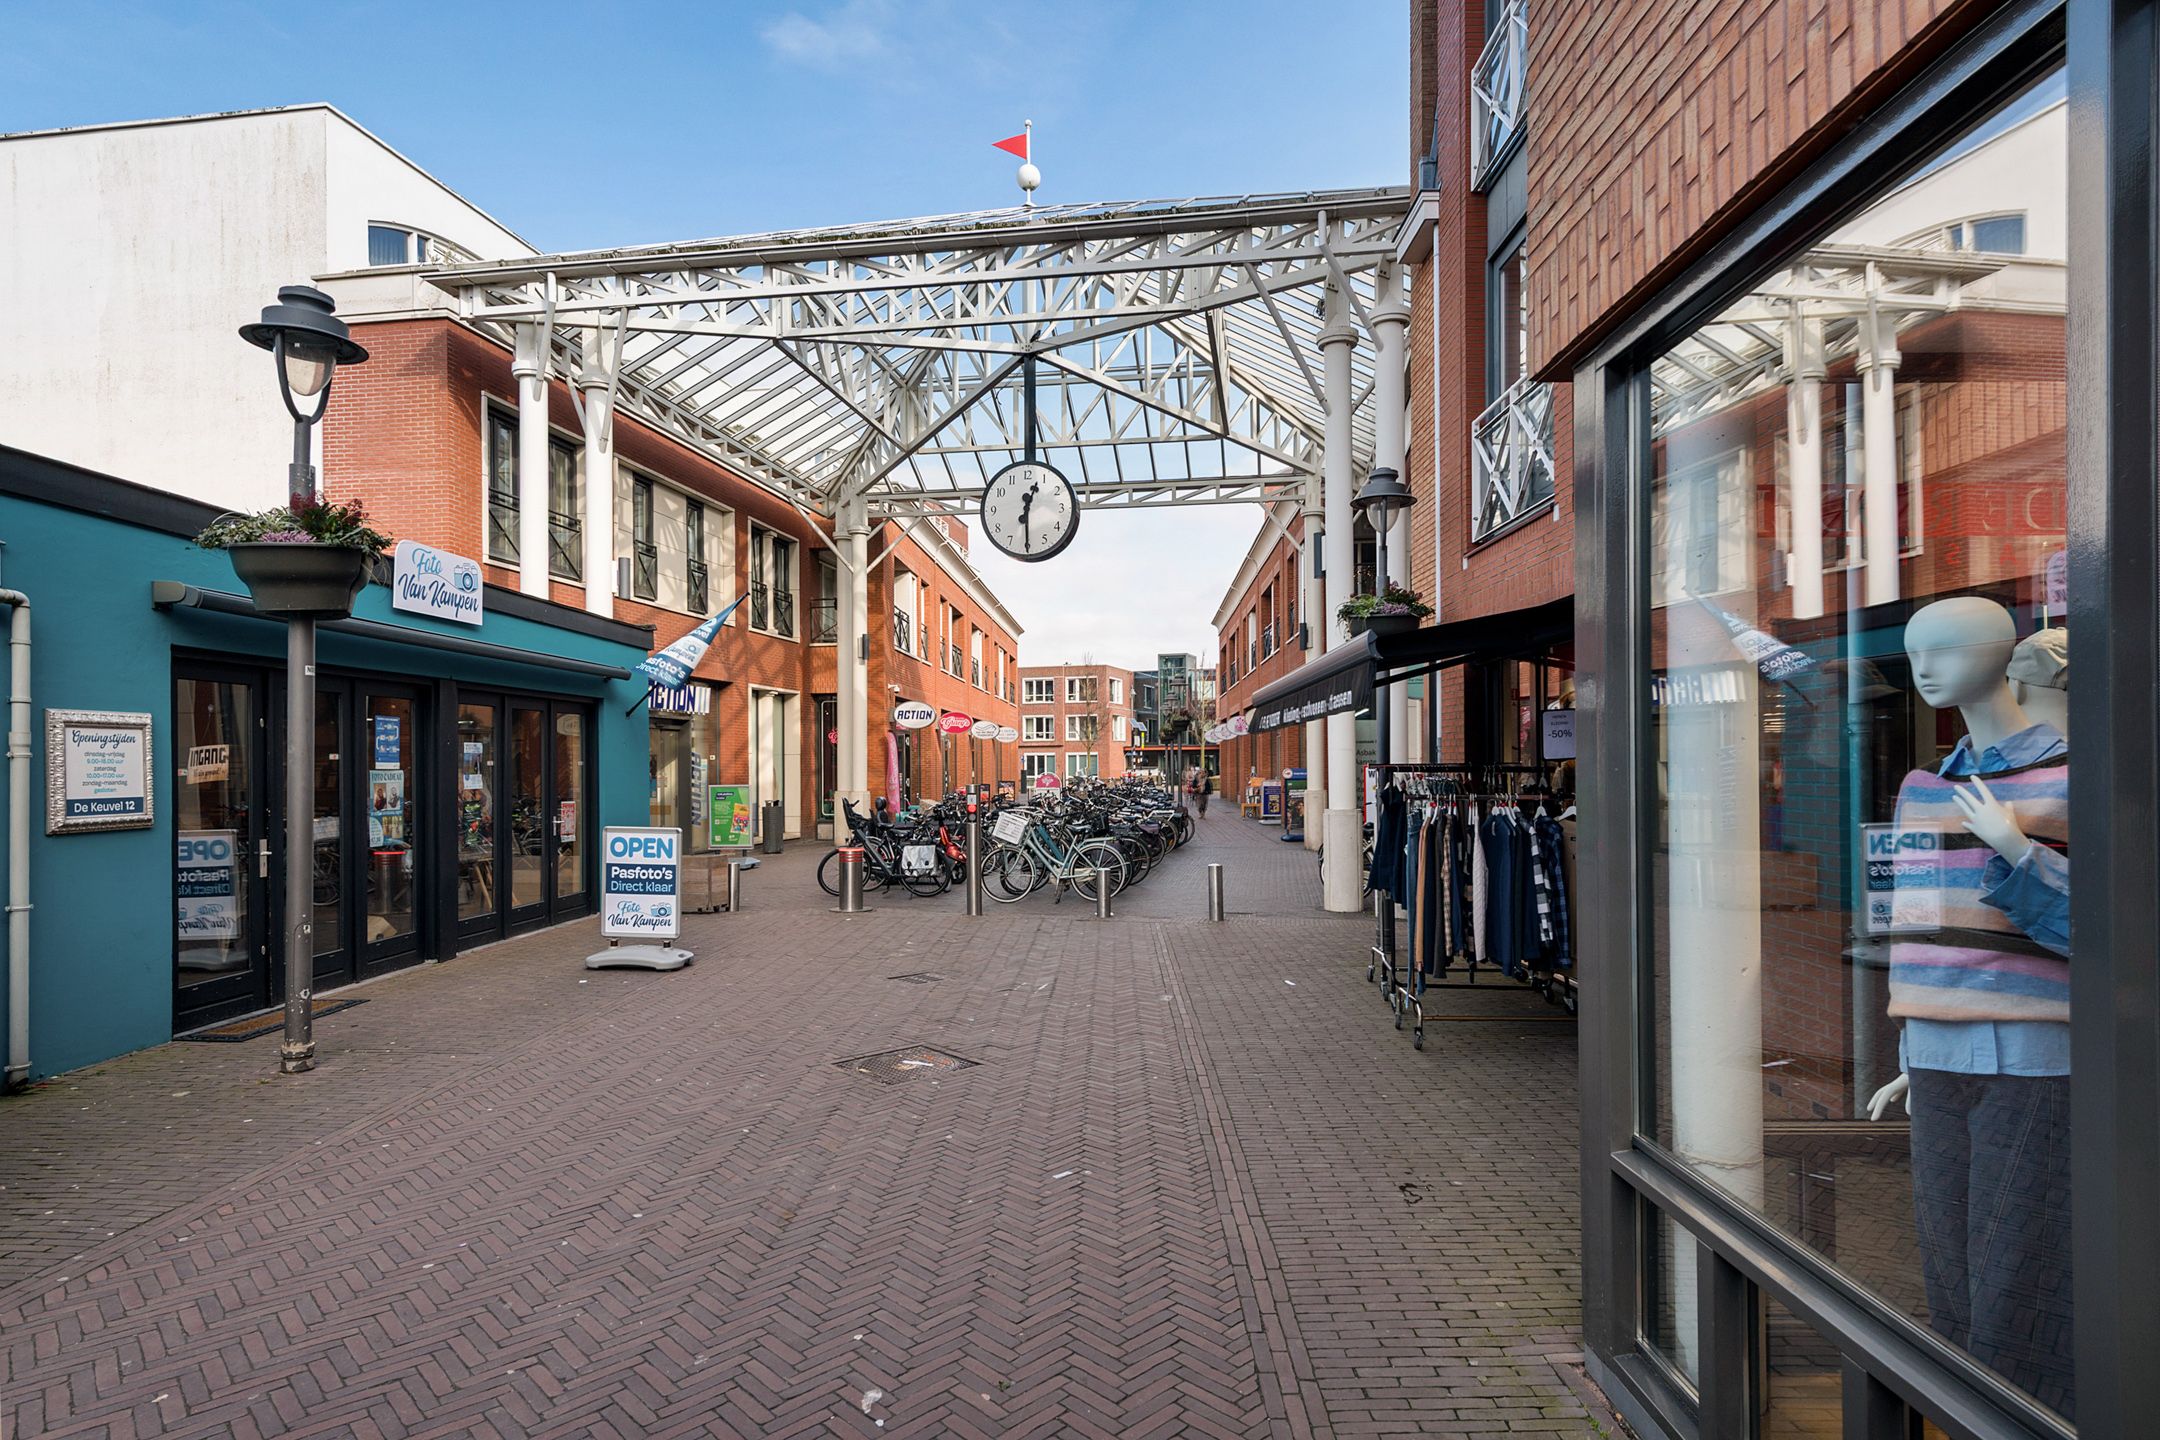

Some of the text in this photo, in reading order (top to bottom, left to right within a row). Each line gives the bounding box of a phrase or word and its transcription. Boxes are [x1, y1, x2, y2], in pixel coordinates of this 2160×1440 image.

[1008, 475, 1016, 485] 11
[1023, 470, 1032, 480] 12
[1042, 474, 1046, 484] 1
[996, 488, 1006, 498] 10
[1054, 486, 1061, 496] 2
[990, 505, 997, 516] 9
[1058, 503, 1065, 514] 3
[995, 522, 1001, 533] 8
[1054, 521, 1060, 531] 4
[1007, 535, 1014, 546] 7
[1042, 534, 1048, 544] 5
[412, 548, 442, 582] Foto
[398, 573, 478, 618] Van Kampen
[897, 710, 932, 720] ACTION
[72, 729, 136, 749] Openingstijden
[1548, 729, 1573, 738] -50%
[691, 752, 702, 826] ACTION
[74, 800, 135, 813] De Keuvel 12
[610, 836, 673, 859] OPEN
[611, 866, 673, 880] Pasfoto's
[611, 880, 673, 893] Direct klaar
[617, 900, 641, 917] Foto
[608, 913, 672, 931] Van Kampen
